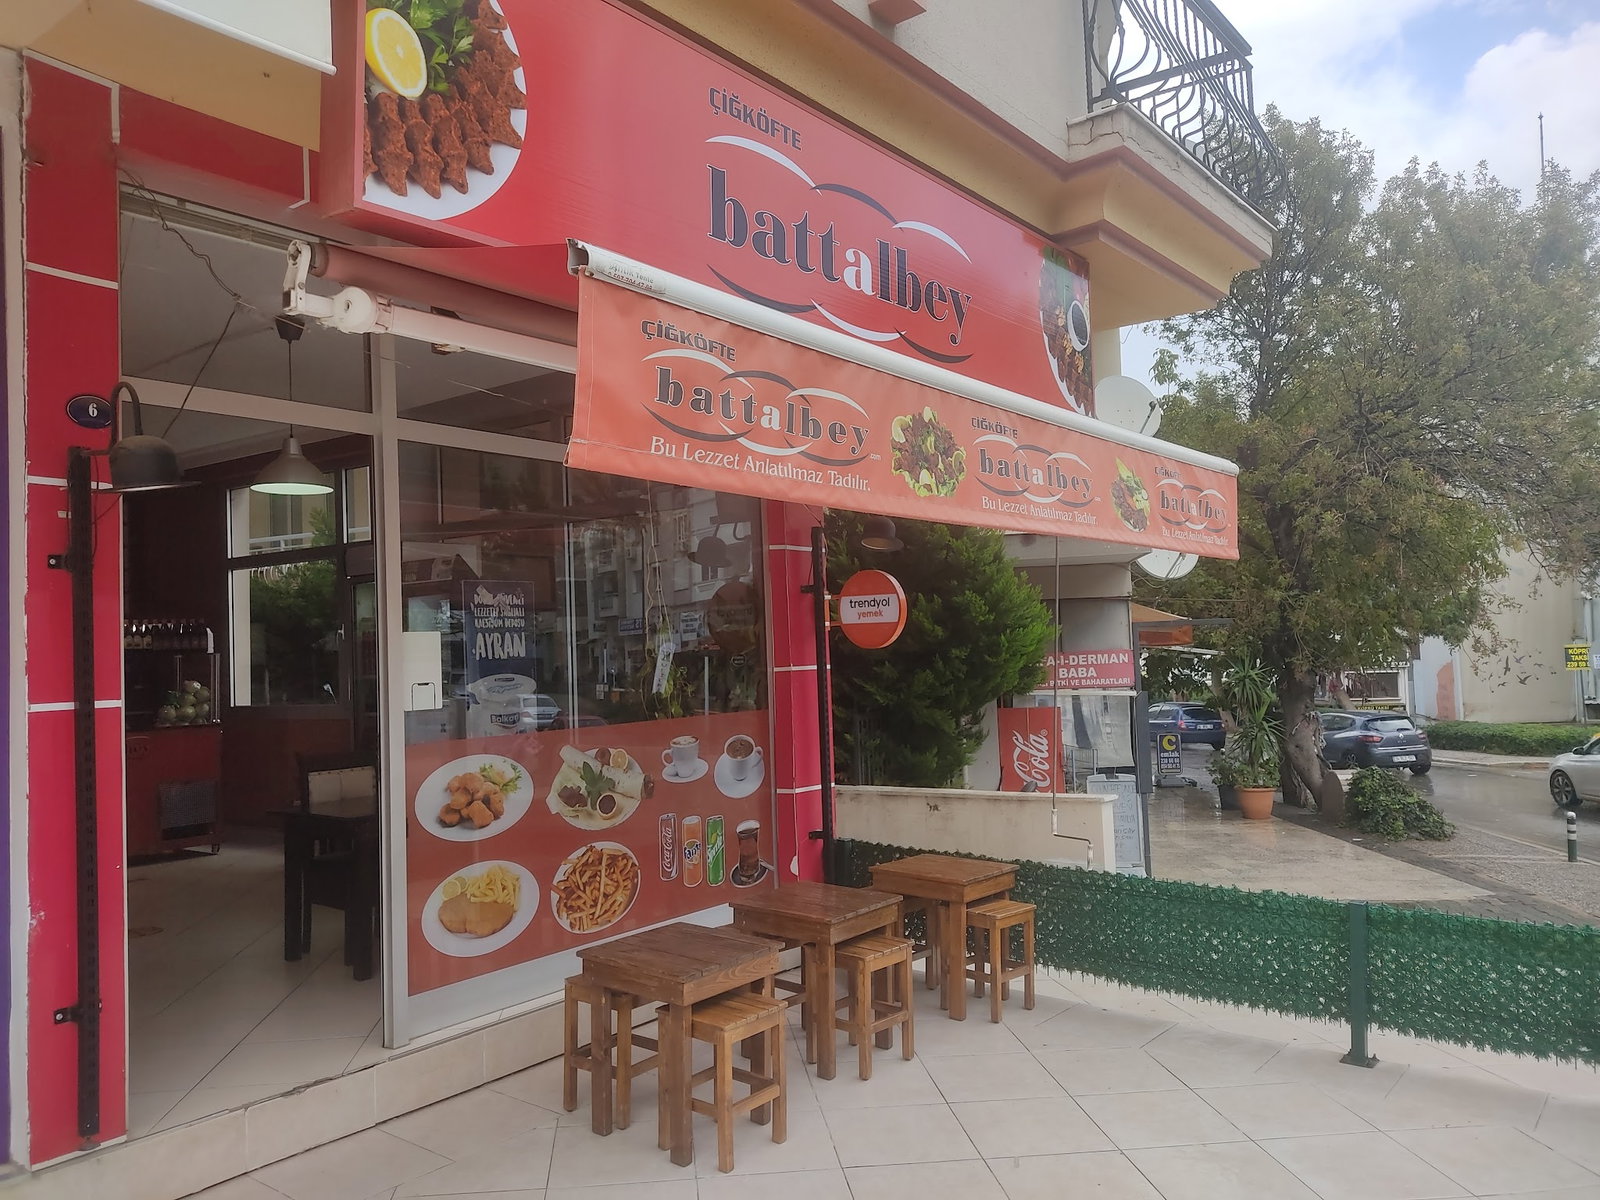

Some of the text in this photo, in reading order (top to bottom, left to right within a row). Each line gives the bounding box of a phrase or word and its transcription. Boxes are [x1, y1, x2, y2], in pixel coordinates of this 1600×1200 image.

[709, 87, 802, 151] ÇİĞKÖFTE
[706, 164, 972, 346] battalbey
[640, 319, 737, 362] ÇİĞKÖFTE
[88, 402, 98, 418] 6
[655, 366, 869, 456] battalbey
[650, 436, 872, 492] Bu Lezzet Anlatılmaz Tadılır.
[978, 447, 1093, 499] battalbey
[981, 495, 996, 510] Bu
[849, 597, 890, 609] trendyol
[857, 609, 884, 619] yemek
[475, 632, 526, 660] AYRAN
[1050, 679, 1069, 687] BTKİ
[1081, 677, 1131, 686] BAHARATLARI
[1059, 667, 1097, 678] BABA
